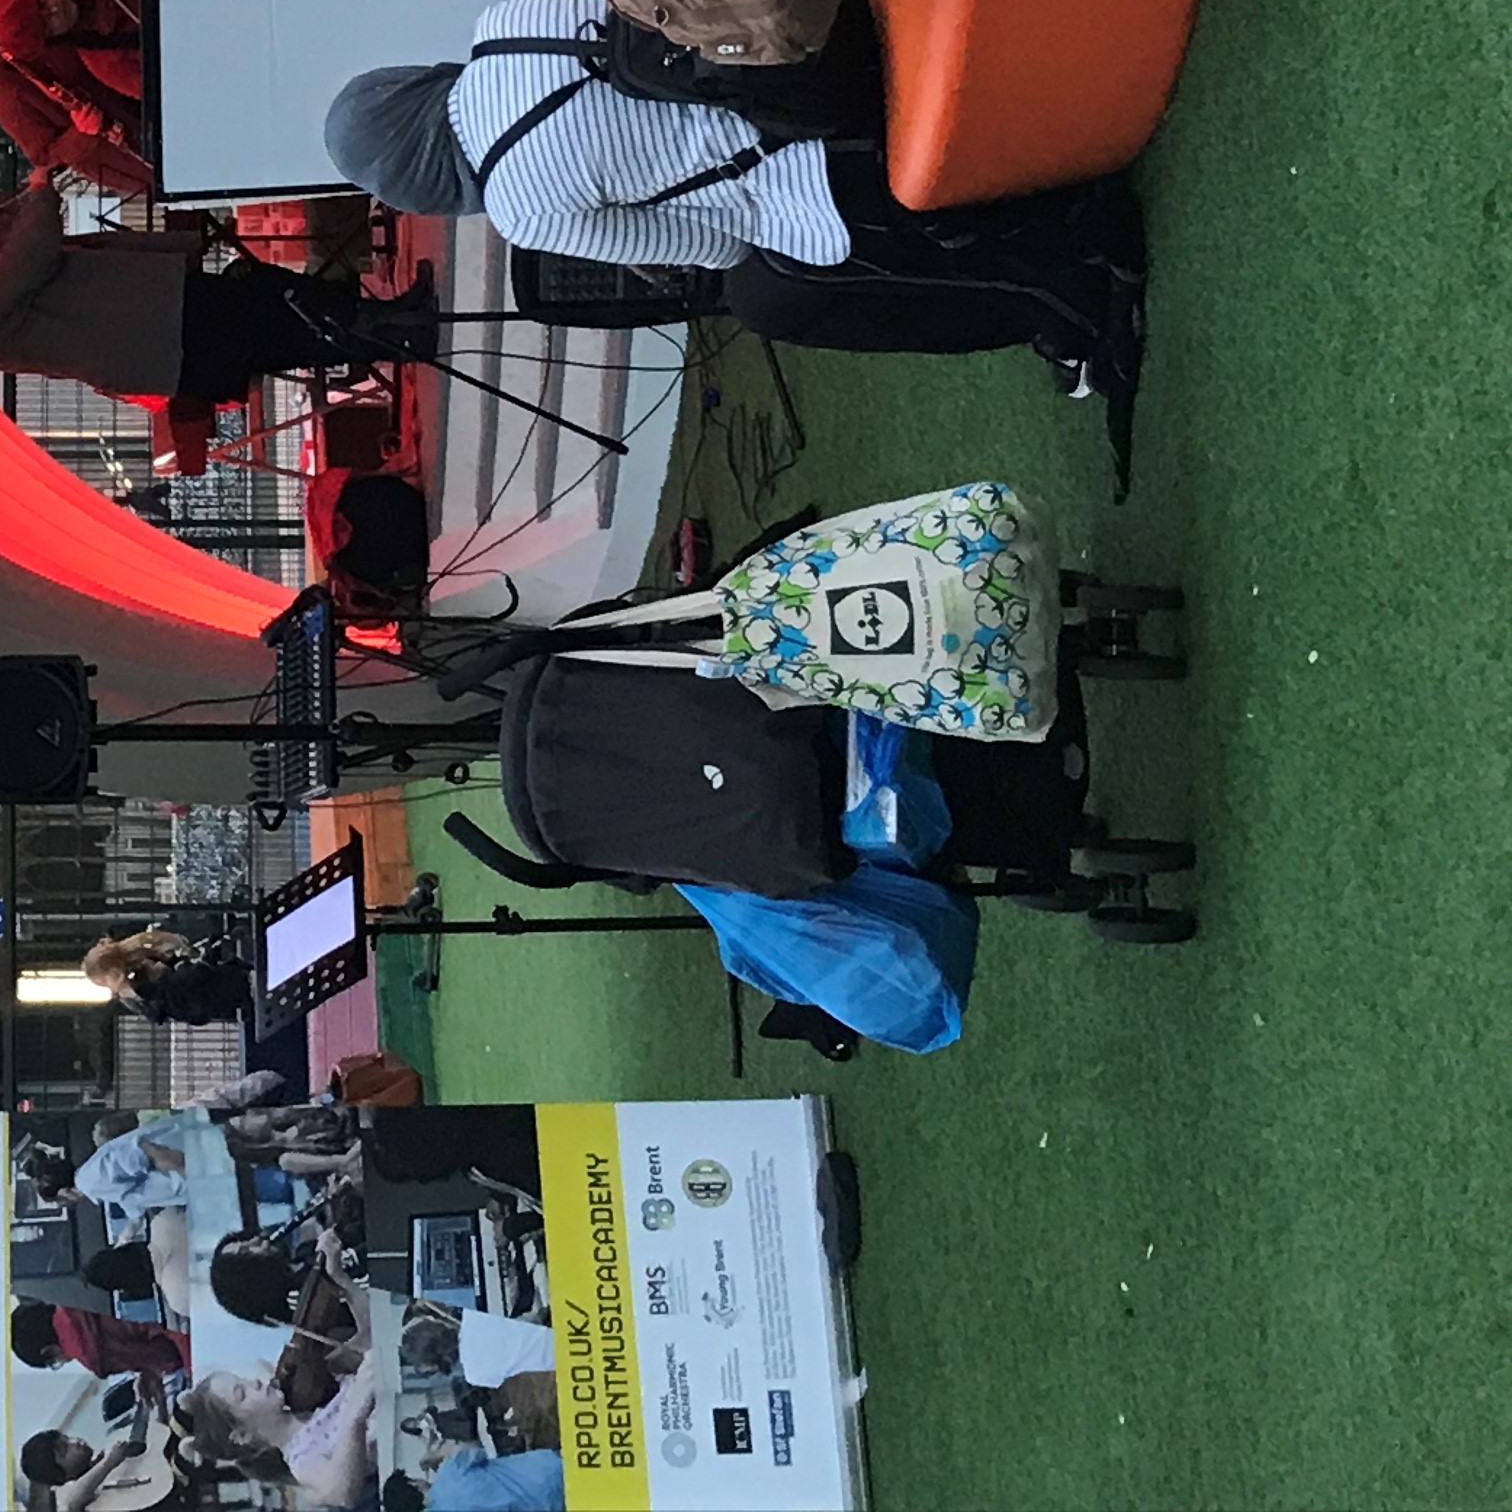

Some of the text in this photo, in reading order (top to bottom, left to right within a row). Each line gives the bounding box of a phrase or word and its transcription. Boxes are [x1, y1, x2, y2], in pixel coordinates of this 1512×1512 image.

[645, 1145, 663, 1194] Brent
[645, 1265, 669, 1315] BMS
[713, 1239, 728, 1310] Young Brent
[586, 1152, 636, 1469] BRENTMUSICACADEMY
[565, 1298, 601, 1469] RPO.CO.UK/
[659, 1394, 670, 1430] ROYAL
[664, 1342, 680, 1430] PHILHARMONIC
[678, 1361, 693, 1431] ORCHESTRA
